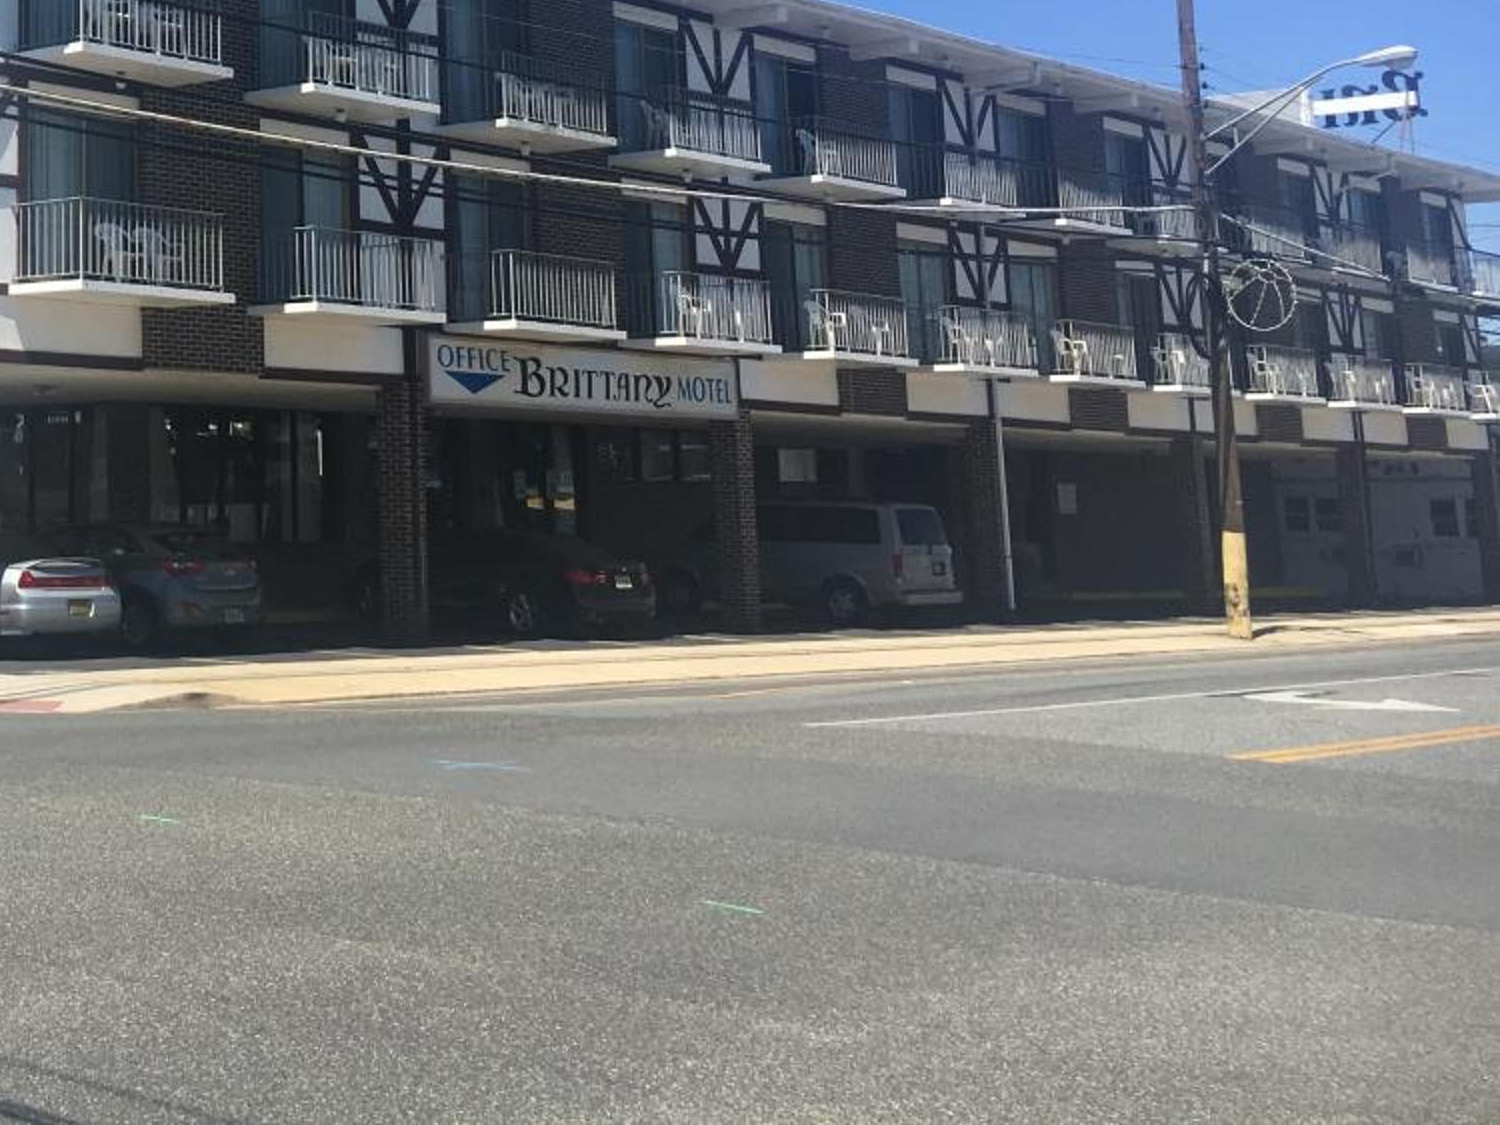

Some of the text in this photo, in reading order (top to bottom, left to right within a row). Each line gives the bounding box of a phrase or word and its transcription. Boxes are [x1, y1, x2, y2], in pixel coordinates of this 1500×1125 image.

[437, 344, 511, 373] OFFICE
[513, 356, 732, 408] BRITTANY MOTEL
